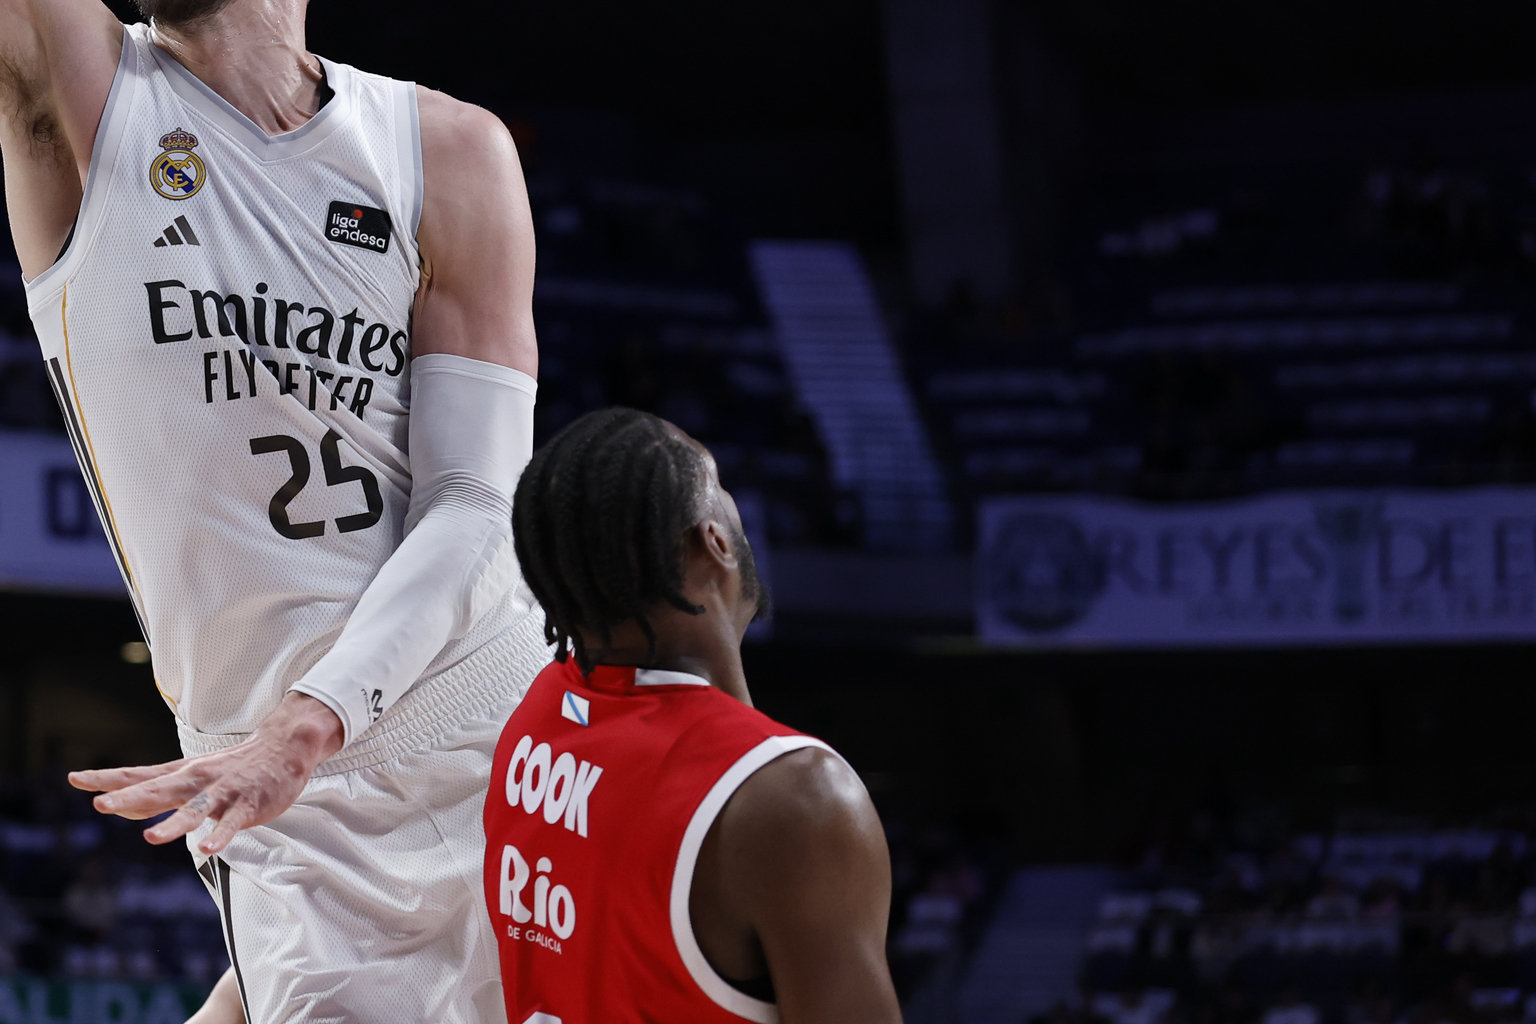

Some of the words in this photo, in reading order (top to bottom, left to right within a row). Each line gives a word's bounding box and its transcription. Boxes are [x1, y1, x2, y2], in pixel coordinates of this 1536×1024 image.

[330, 227, 386, 249] endesa
[332, 213, 359, 228] liga
[144, 279, 407, 377] Emirates
[204, 349, 257, 404] FLY
[249, 427, 384, 540] 25
[1096, 523, 1327, 596] REYES
[505, 735, 604, 838] COOK
[508, 924, 521, 940] DE
[525, 929, 562, 955] GALICIA
